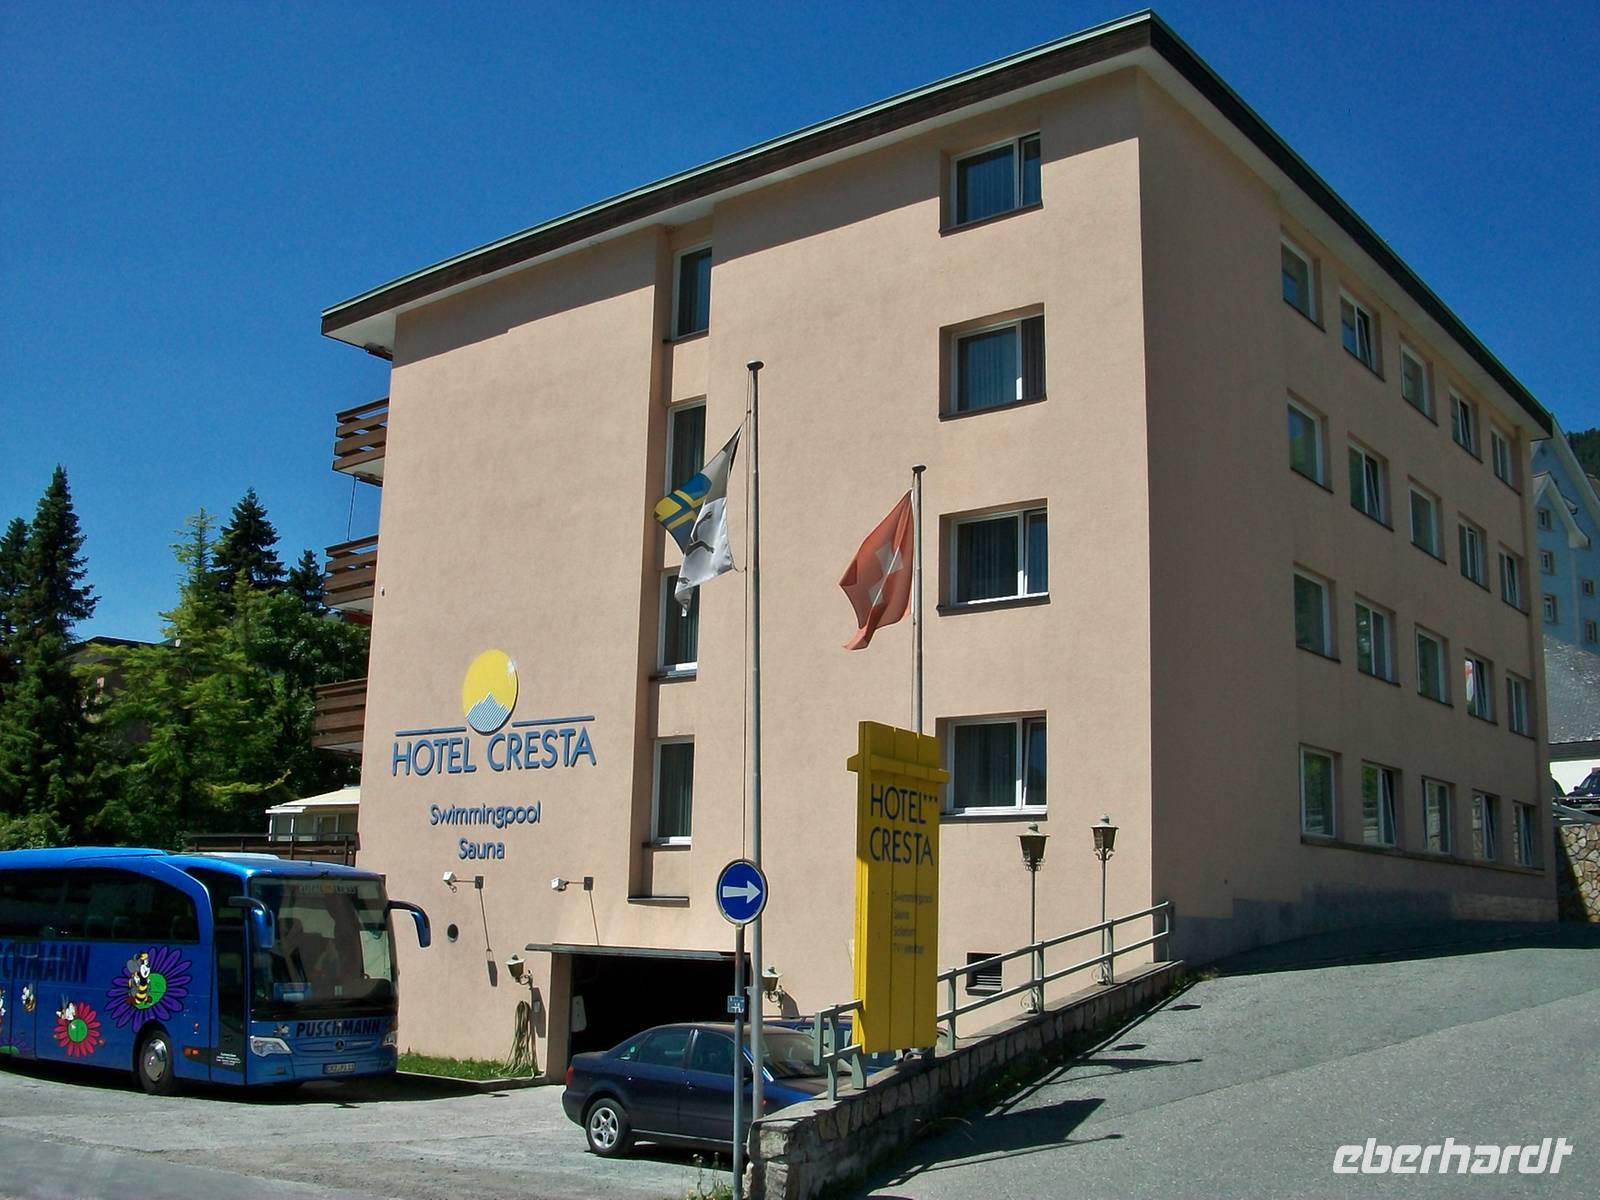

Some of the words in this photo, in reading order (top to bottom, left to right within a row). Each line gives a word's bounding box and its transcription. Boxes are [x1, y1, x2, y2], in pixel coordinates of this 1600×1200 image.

[391, 737, 477, 776] HOTEL
[487, 727, 597, 772] CRESTA
[430, 801, 541, 828] Swimmingpool
[870, 783, 927, 825] HOTEL
[459, 837, 505, 860] Sauna
[870, 826, 935, 866] CRESTA
